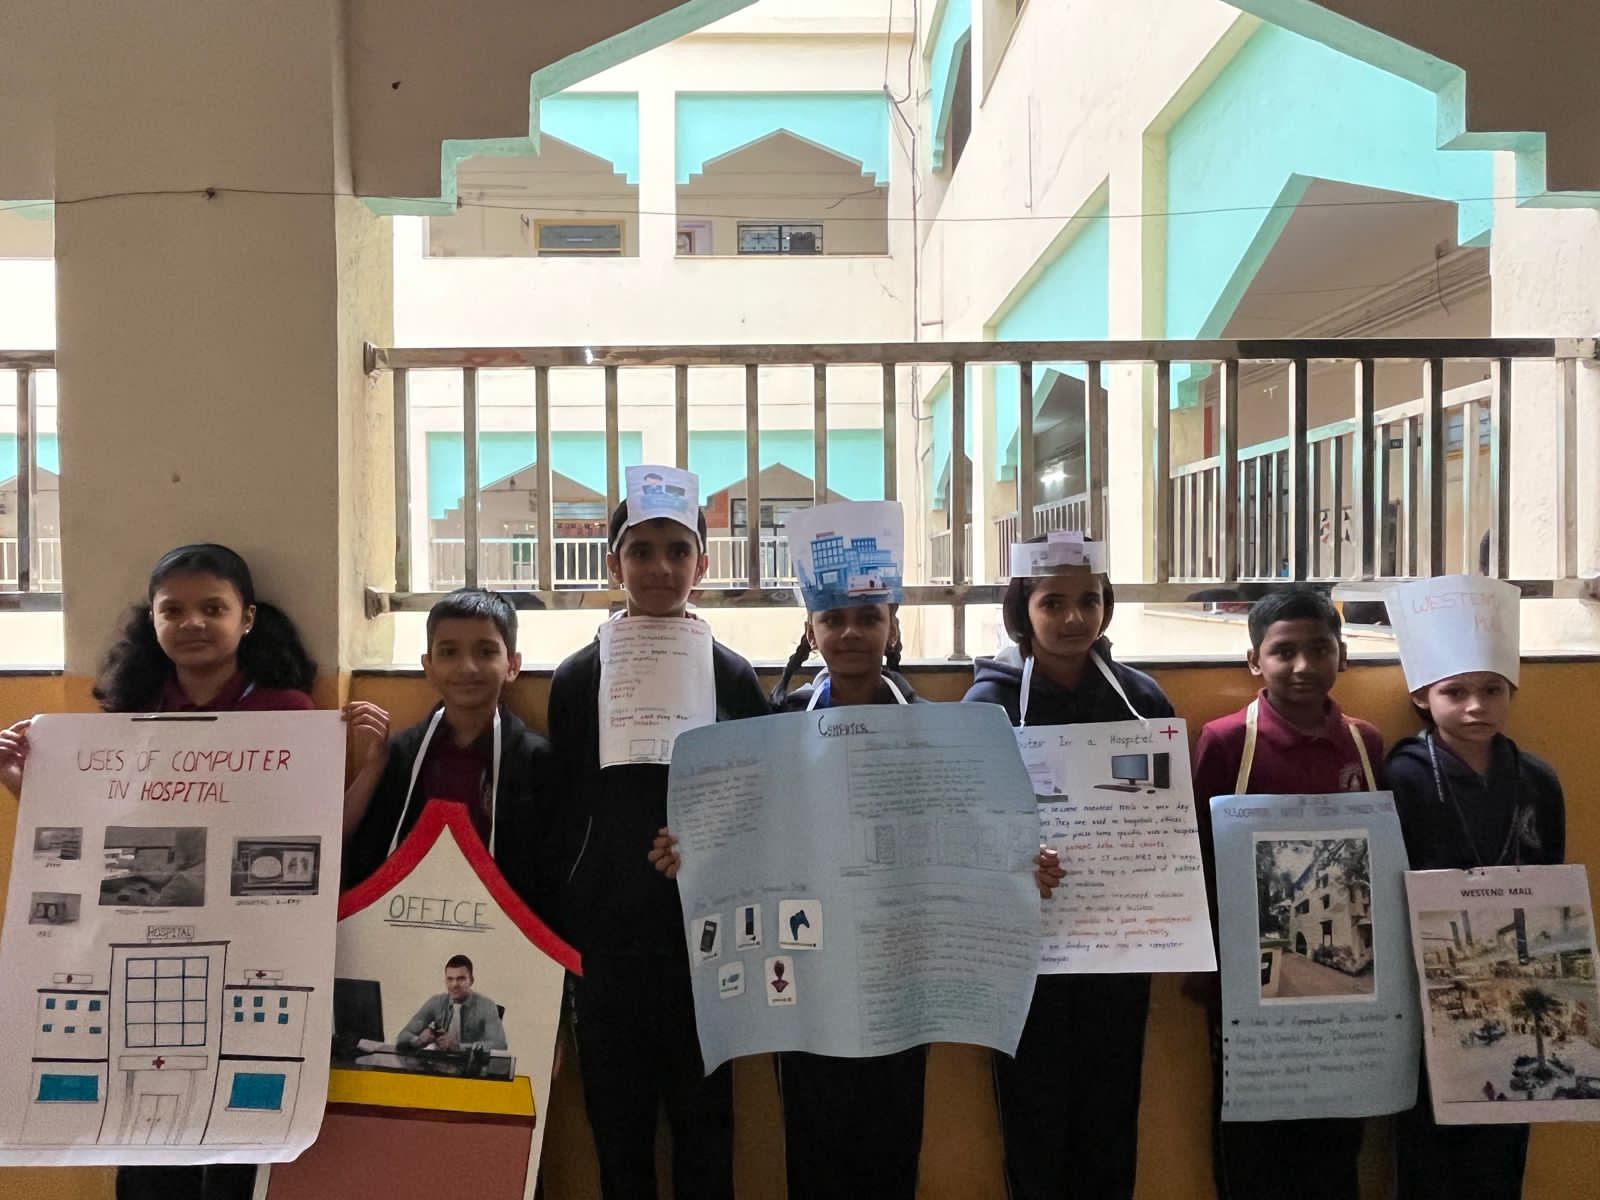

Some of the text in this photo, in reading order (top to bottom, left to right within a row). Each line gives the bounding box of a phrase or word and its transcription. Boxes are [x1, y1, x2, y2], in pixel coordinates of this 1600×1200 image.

[76, 749, 291, 772] USES OF COMPUTER
[107, 780, 231, 803] IN HOSPITAL
[388, 894, 488, 928] OFFICE
[147, 925, 194, 939] HOSPITAL
